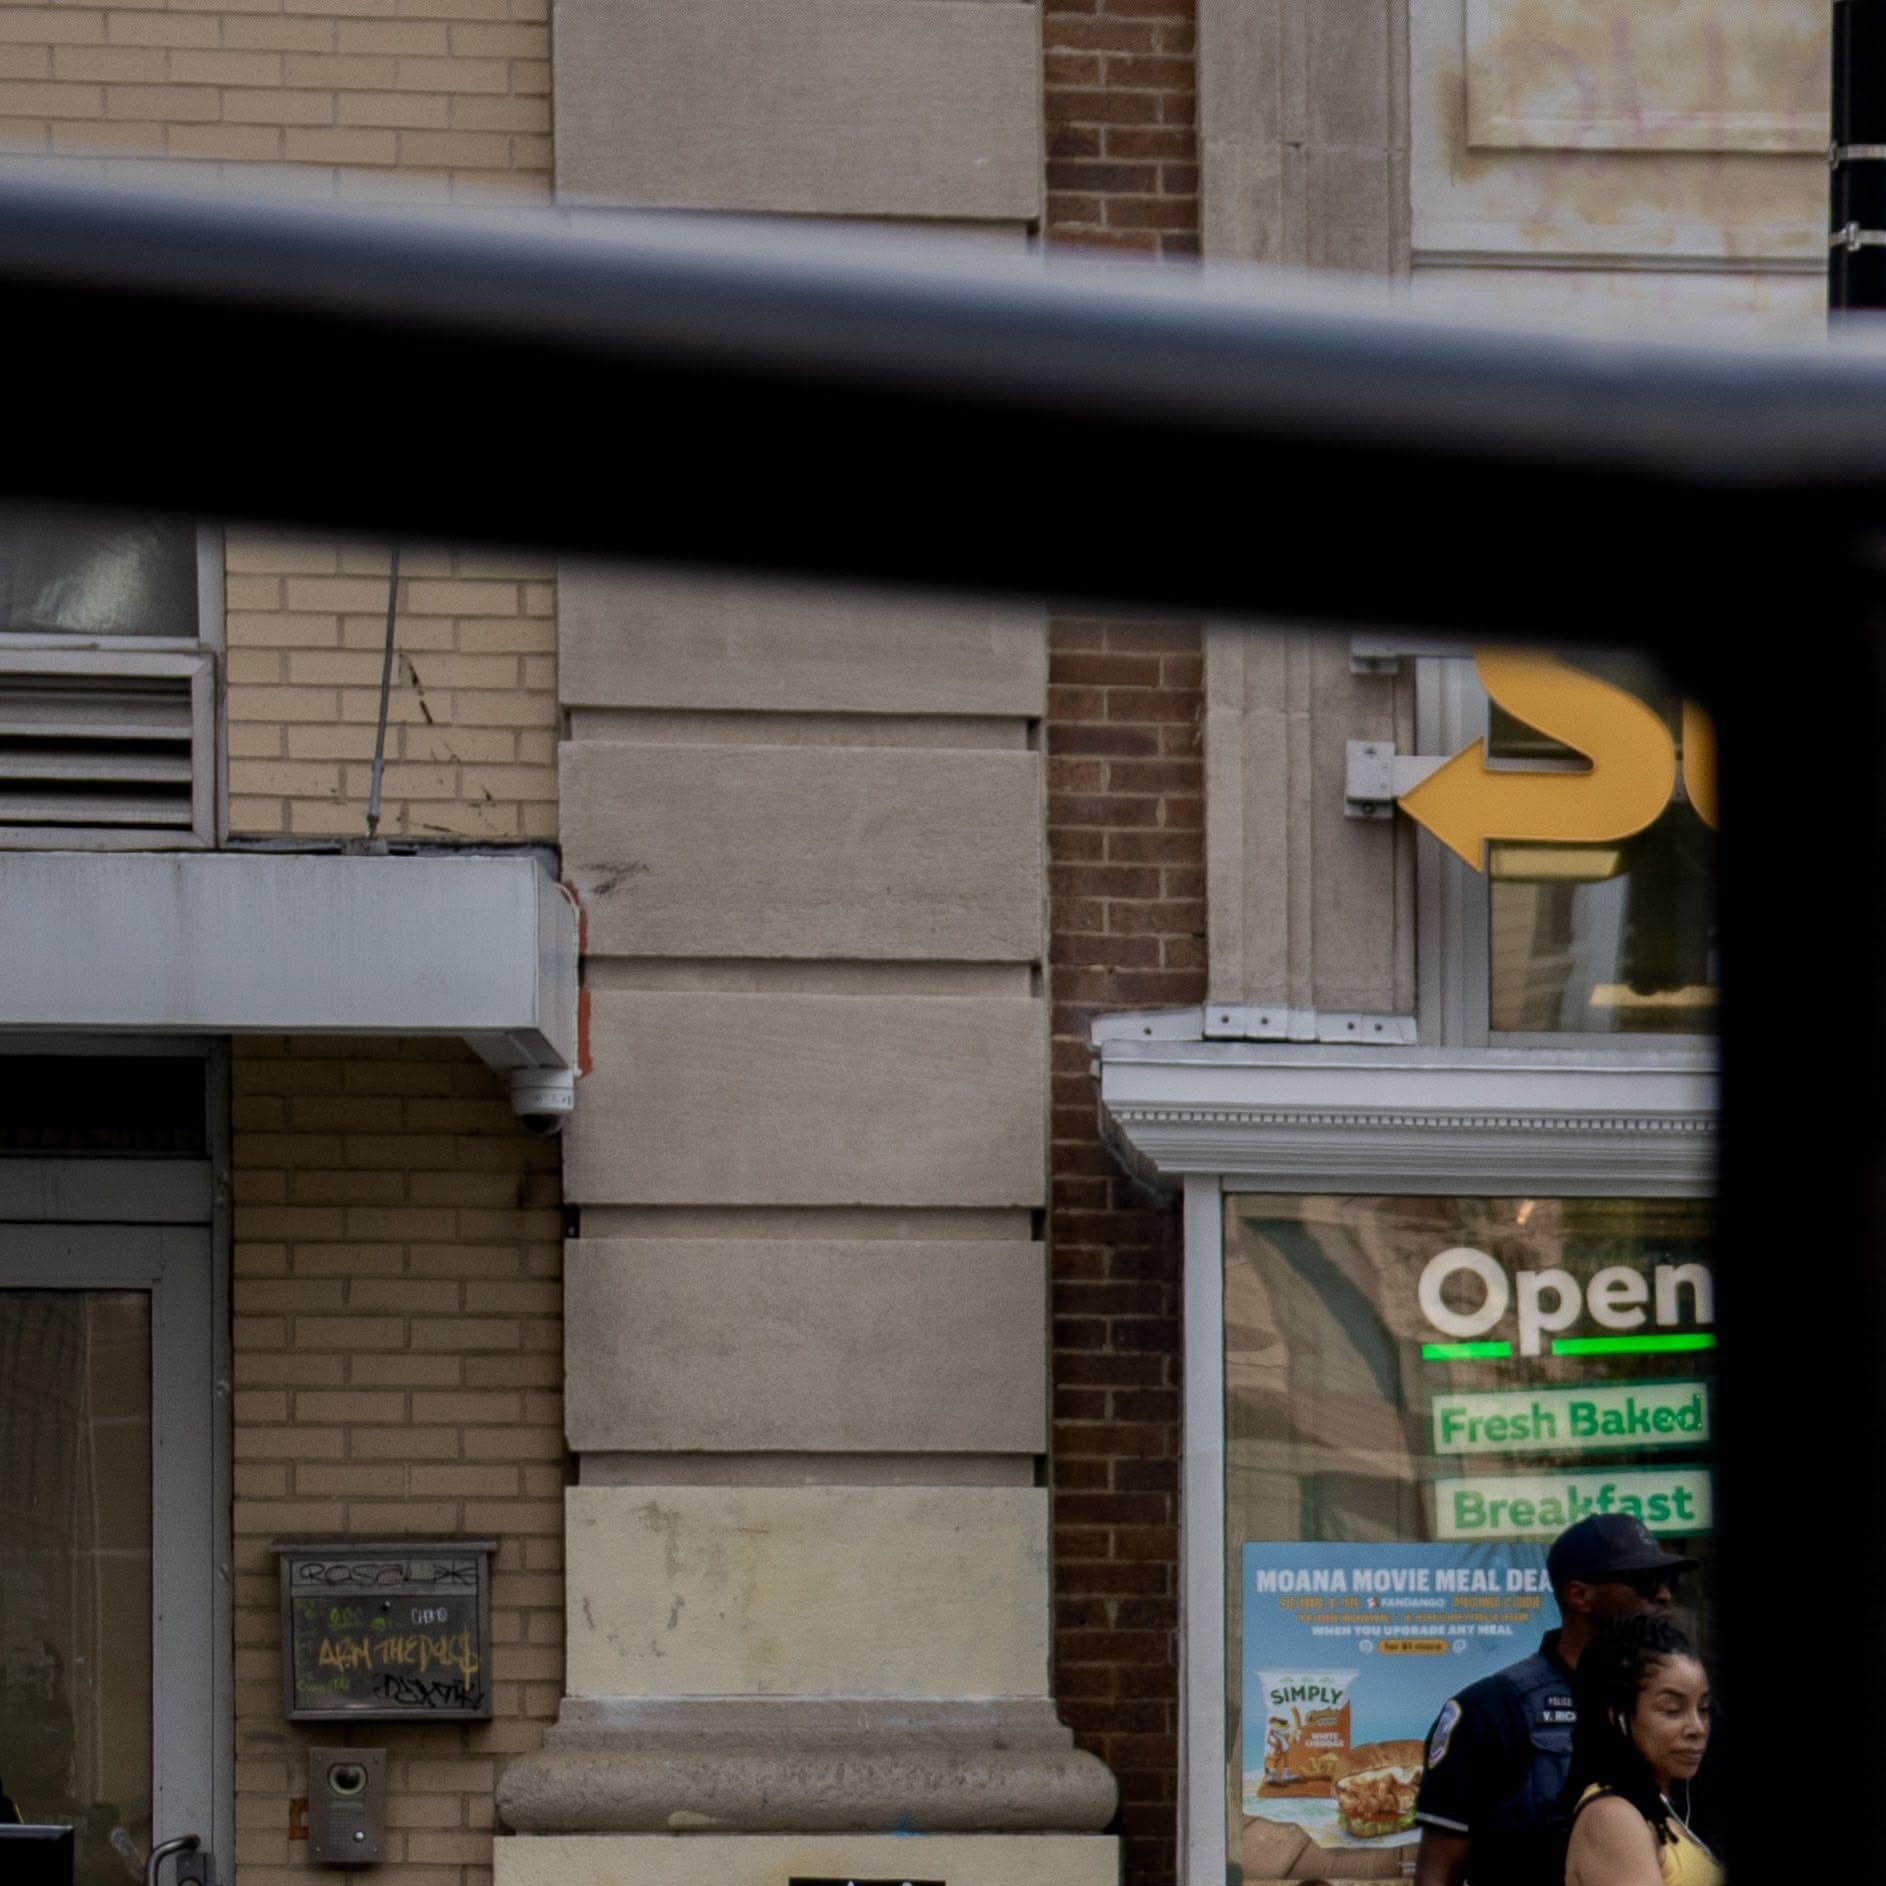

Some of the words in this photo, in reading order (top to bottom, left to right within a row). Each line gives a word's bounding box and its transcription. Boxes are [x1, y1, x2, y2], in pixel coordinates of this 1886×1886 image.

[1418, 1247, 1716, 1356] Open
[1441, 1402, 1556, 1444] Fresh
[1568, 1394, 1704, 1439] Baked
[1256, 1569, 1346, 1592] MOANA
[1353, 1568, 1429, 1592] MOVIE
[1435, 1568, 1499, 1592] MEAL
[1506, 1568, 1554, 1592] DEA
[1312, 1625, 1350, 1636] WHEN
[1354, 1625, 1380, 1636] YOU
[1383, 1625, 1445, 1636] UPGRADE
[1448, 1624, 1474, 1636] ANY
[1477, 1624, 1513, 1636] MEAL
[1270, 1686, 1344, 1705] SIMPLY
